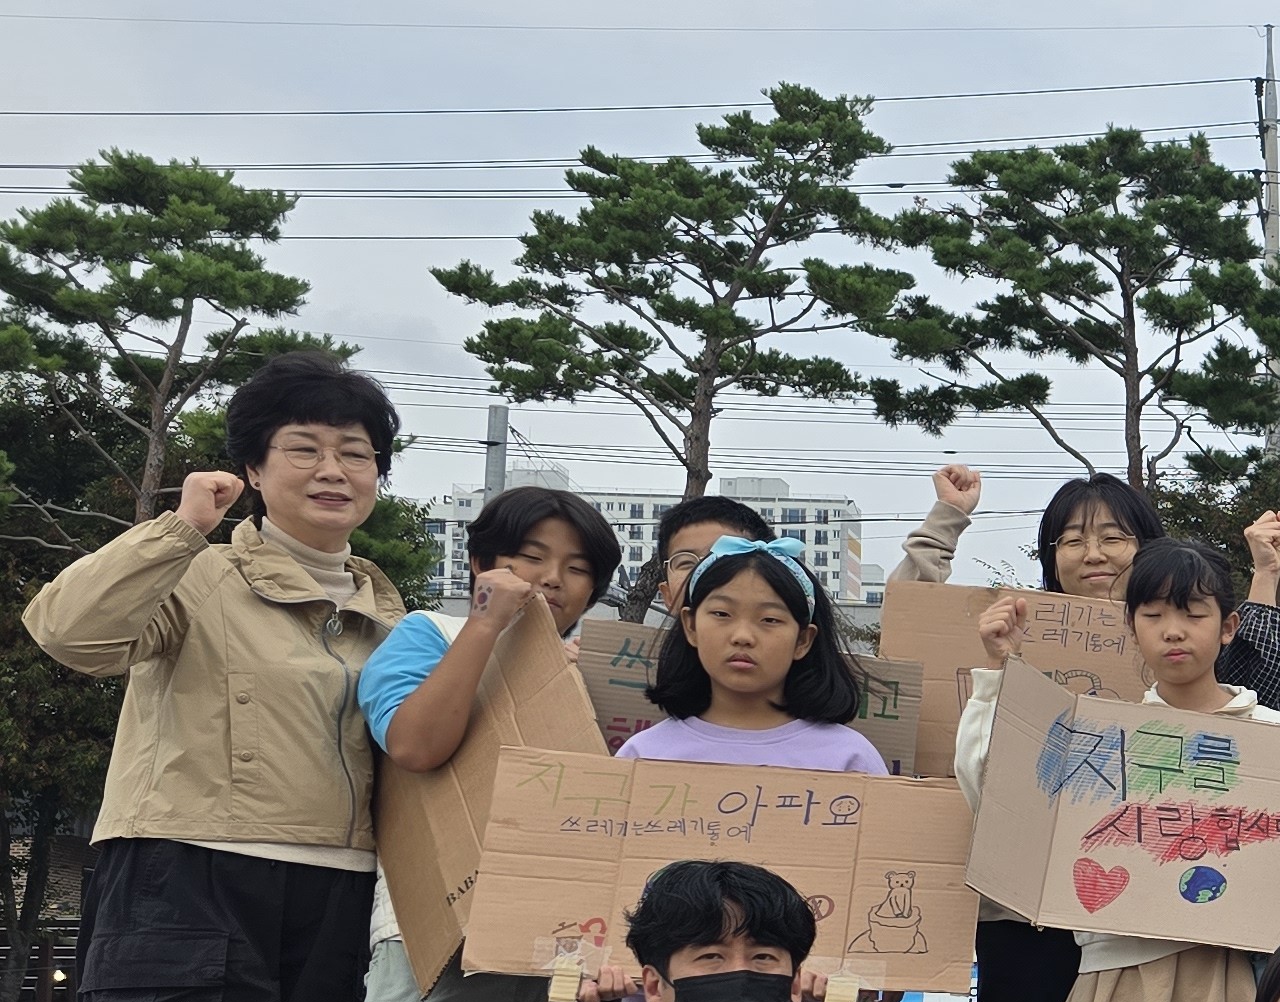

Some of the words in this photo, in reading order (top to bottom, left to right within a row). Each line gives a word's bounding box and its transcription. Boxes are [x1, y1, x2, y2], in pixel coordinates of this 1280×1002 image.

[515, 762, 698, 816] 지구가
[717, 784, 861, 827] 아파요
[1050, 720, 1237, 801] 지구를
